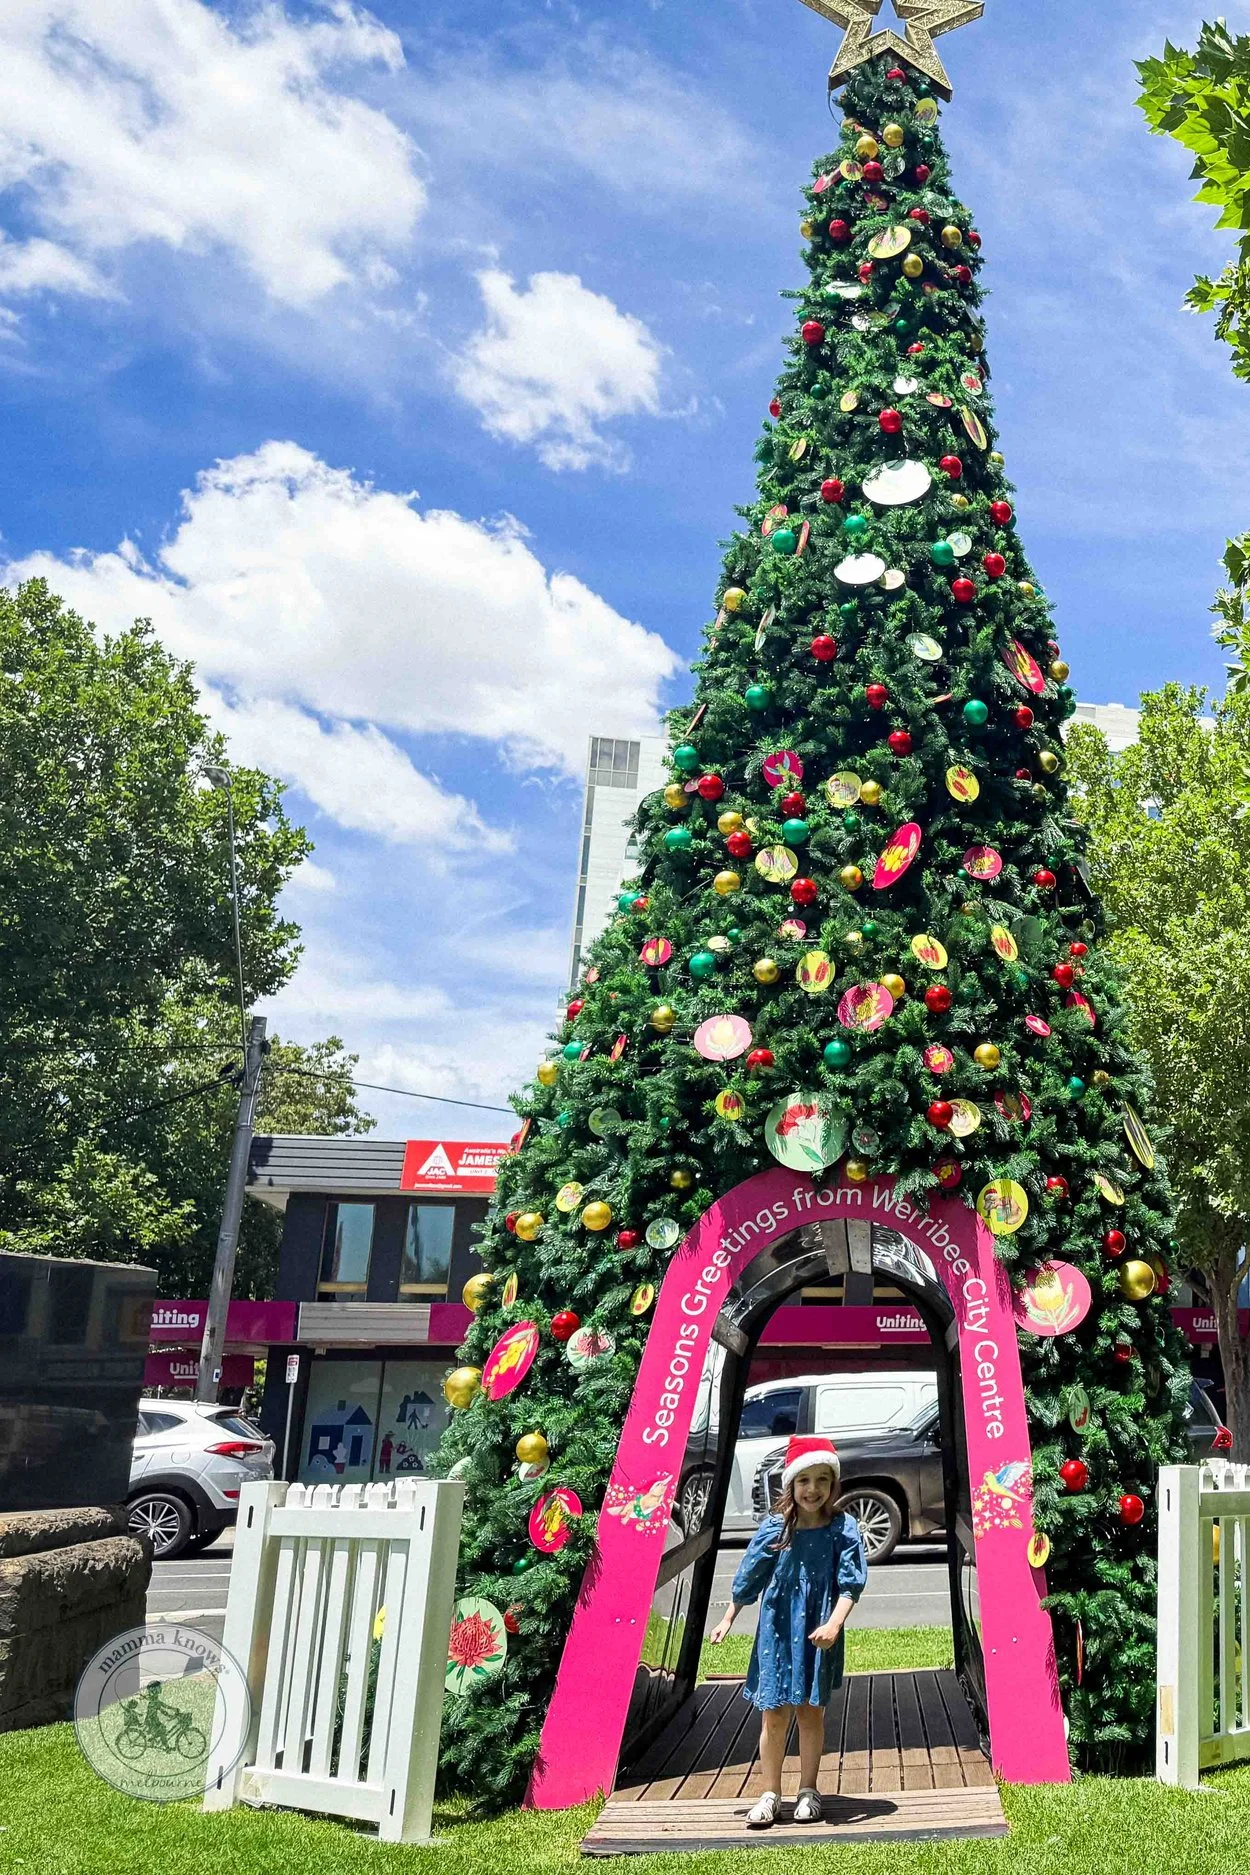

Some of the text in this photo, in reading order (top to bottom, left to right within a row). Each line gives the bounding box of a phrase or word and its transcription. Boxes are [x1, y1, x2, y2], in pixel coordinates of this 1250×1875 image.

[427, 1167, 446, 1176] JAC
[151, 1308, 199, 1328] niting
[642, 1185, 1004, 1447] Seasons Greetings from Werribee City Centre
